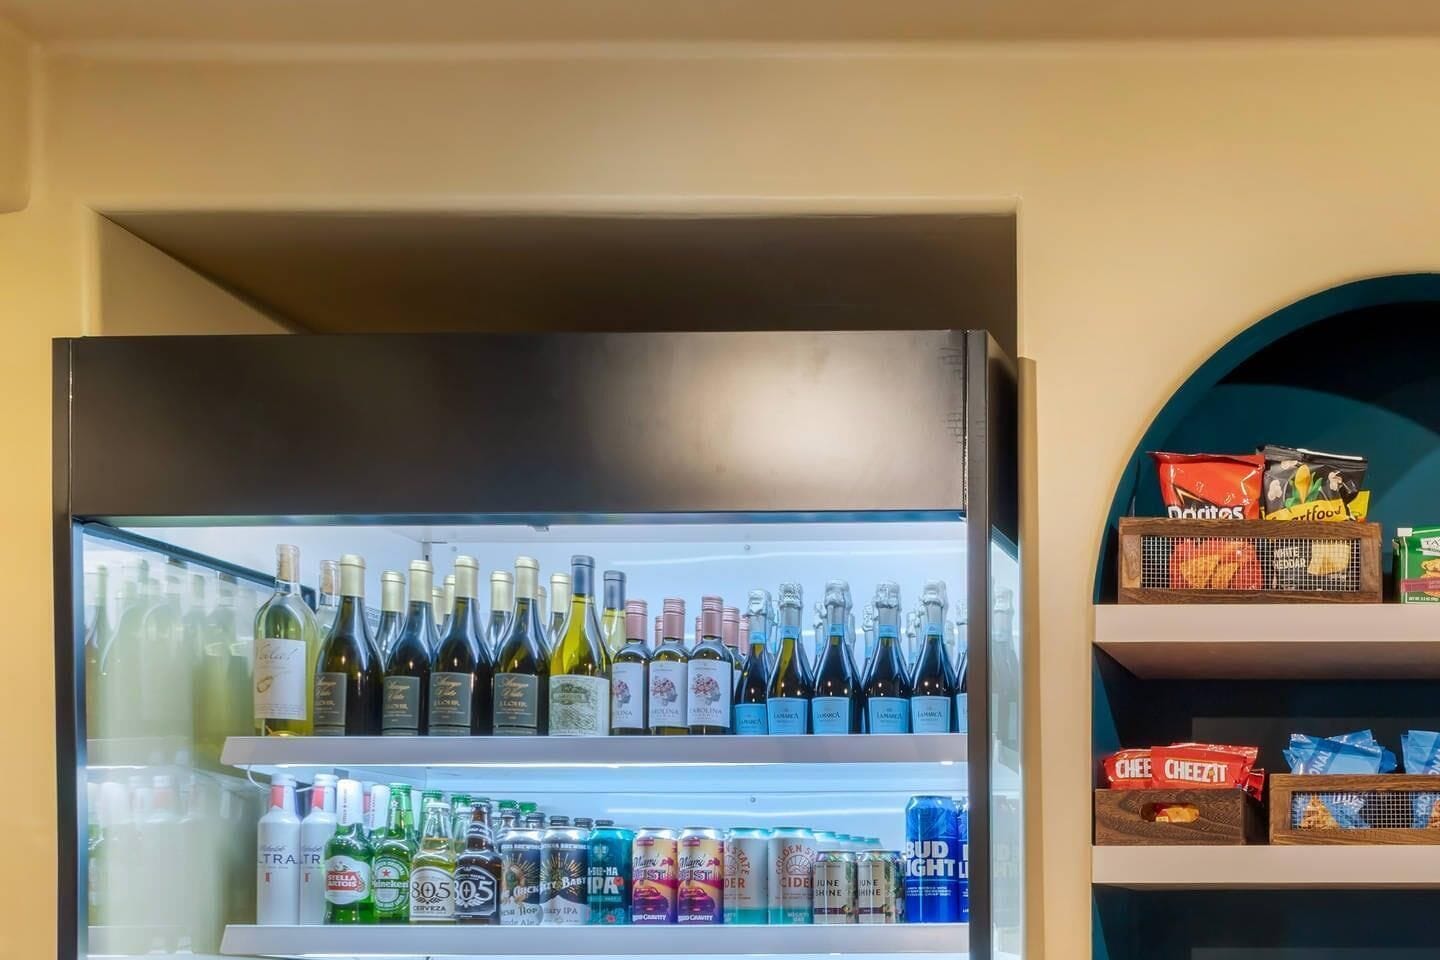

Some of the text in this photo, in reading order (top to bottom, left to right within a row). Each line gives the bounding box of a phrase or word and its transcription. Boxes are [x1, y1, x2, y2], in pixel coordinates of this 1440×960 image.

[1115, 758, 1152, 779] CHEE
[257, 853, 297, 864] TRA
[906, 840, 949, 859] BUD
[327, 874, 356, 882] STELLA
[587, 876, 619, 894] IPA
[816, 879, 840, 887] JUNE
[412, 881, 451, 899] 805
